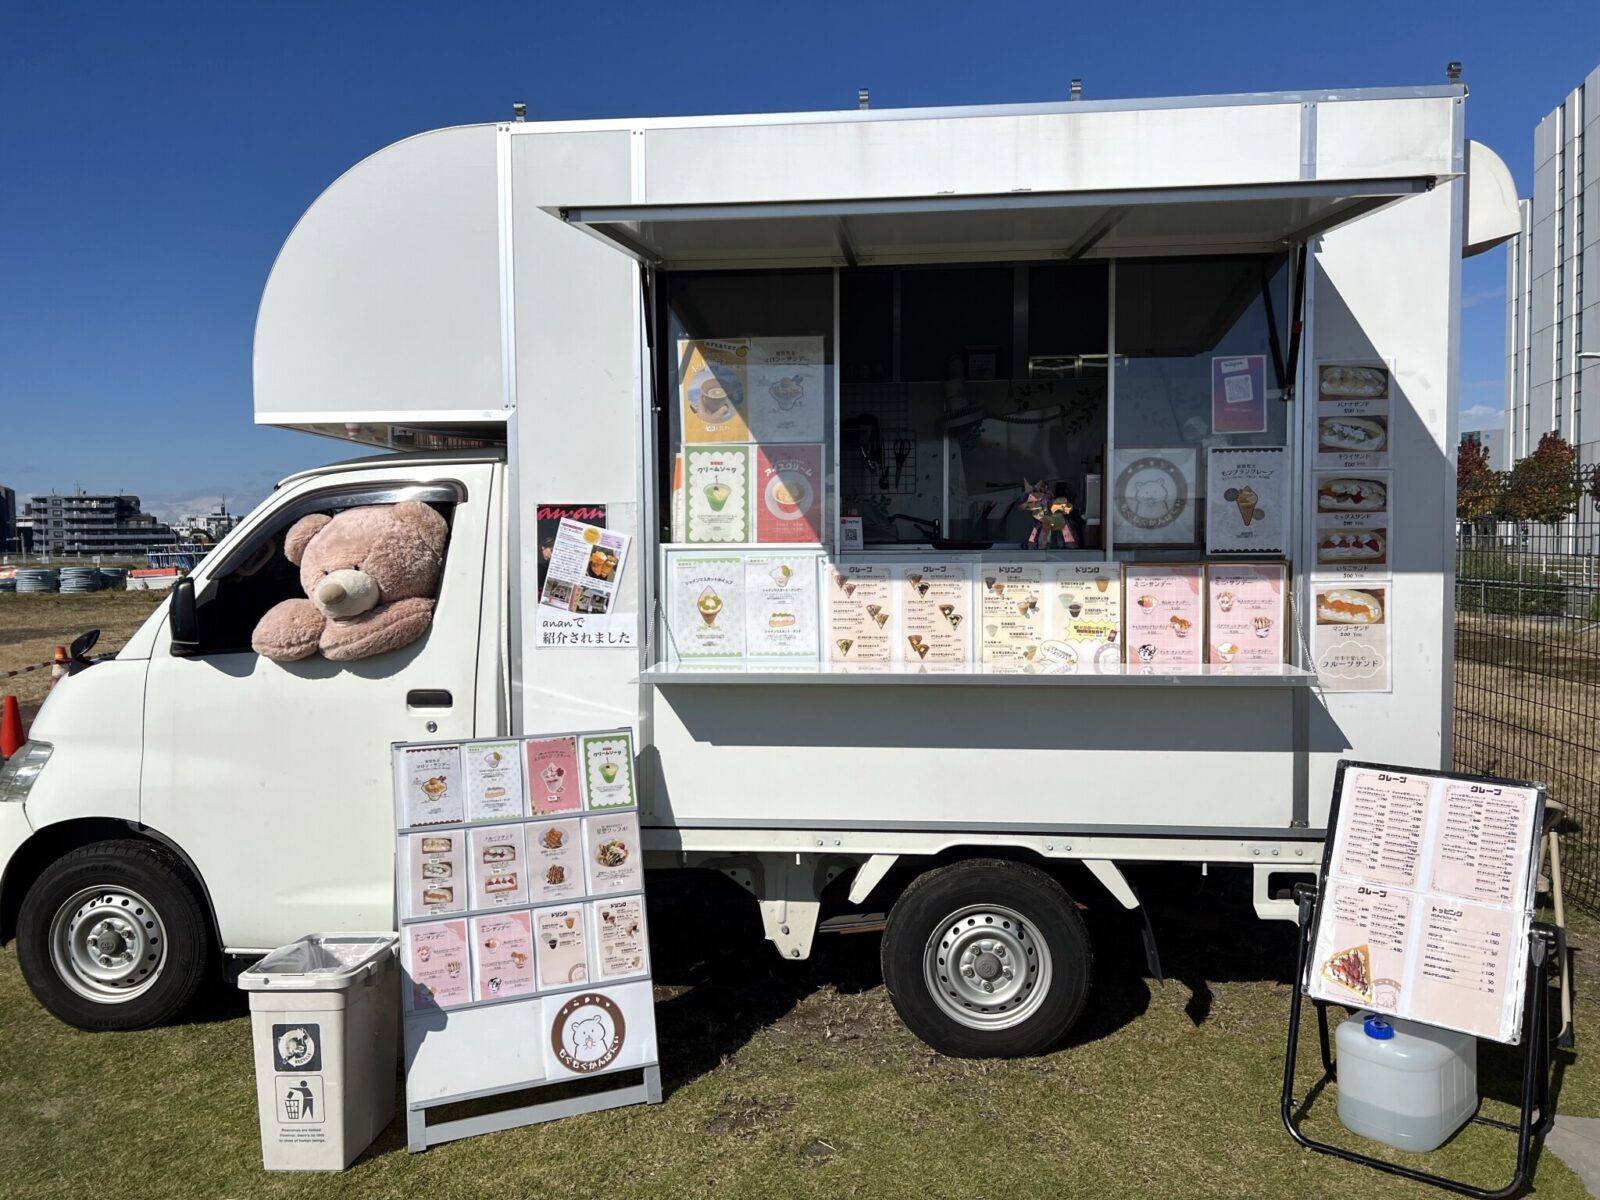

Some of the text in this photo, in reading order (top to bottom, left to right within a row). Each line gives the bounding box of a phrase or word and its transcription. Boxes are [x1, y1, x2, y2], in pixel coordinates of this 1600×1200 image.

[543, 631, 631, 644] 紹介されました
[1322, 660, 1379, 668] フルーツサンド
[1378, 773, 1408, 784] クレープ
[1470, 785, 1502, 797] クレープ
[1358, 886, 1388, 898] クレープ
[1432, 906, 1463, 917] トッピング
